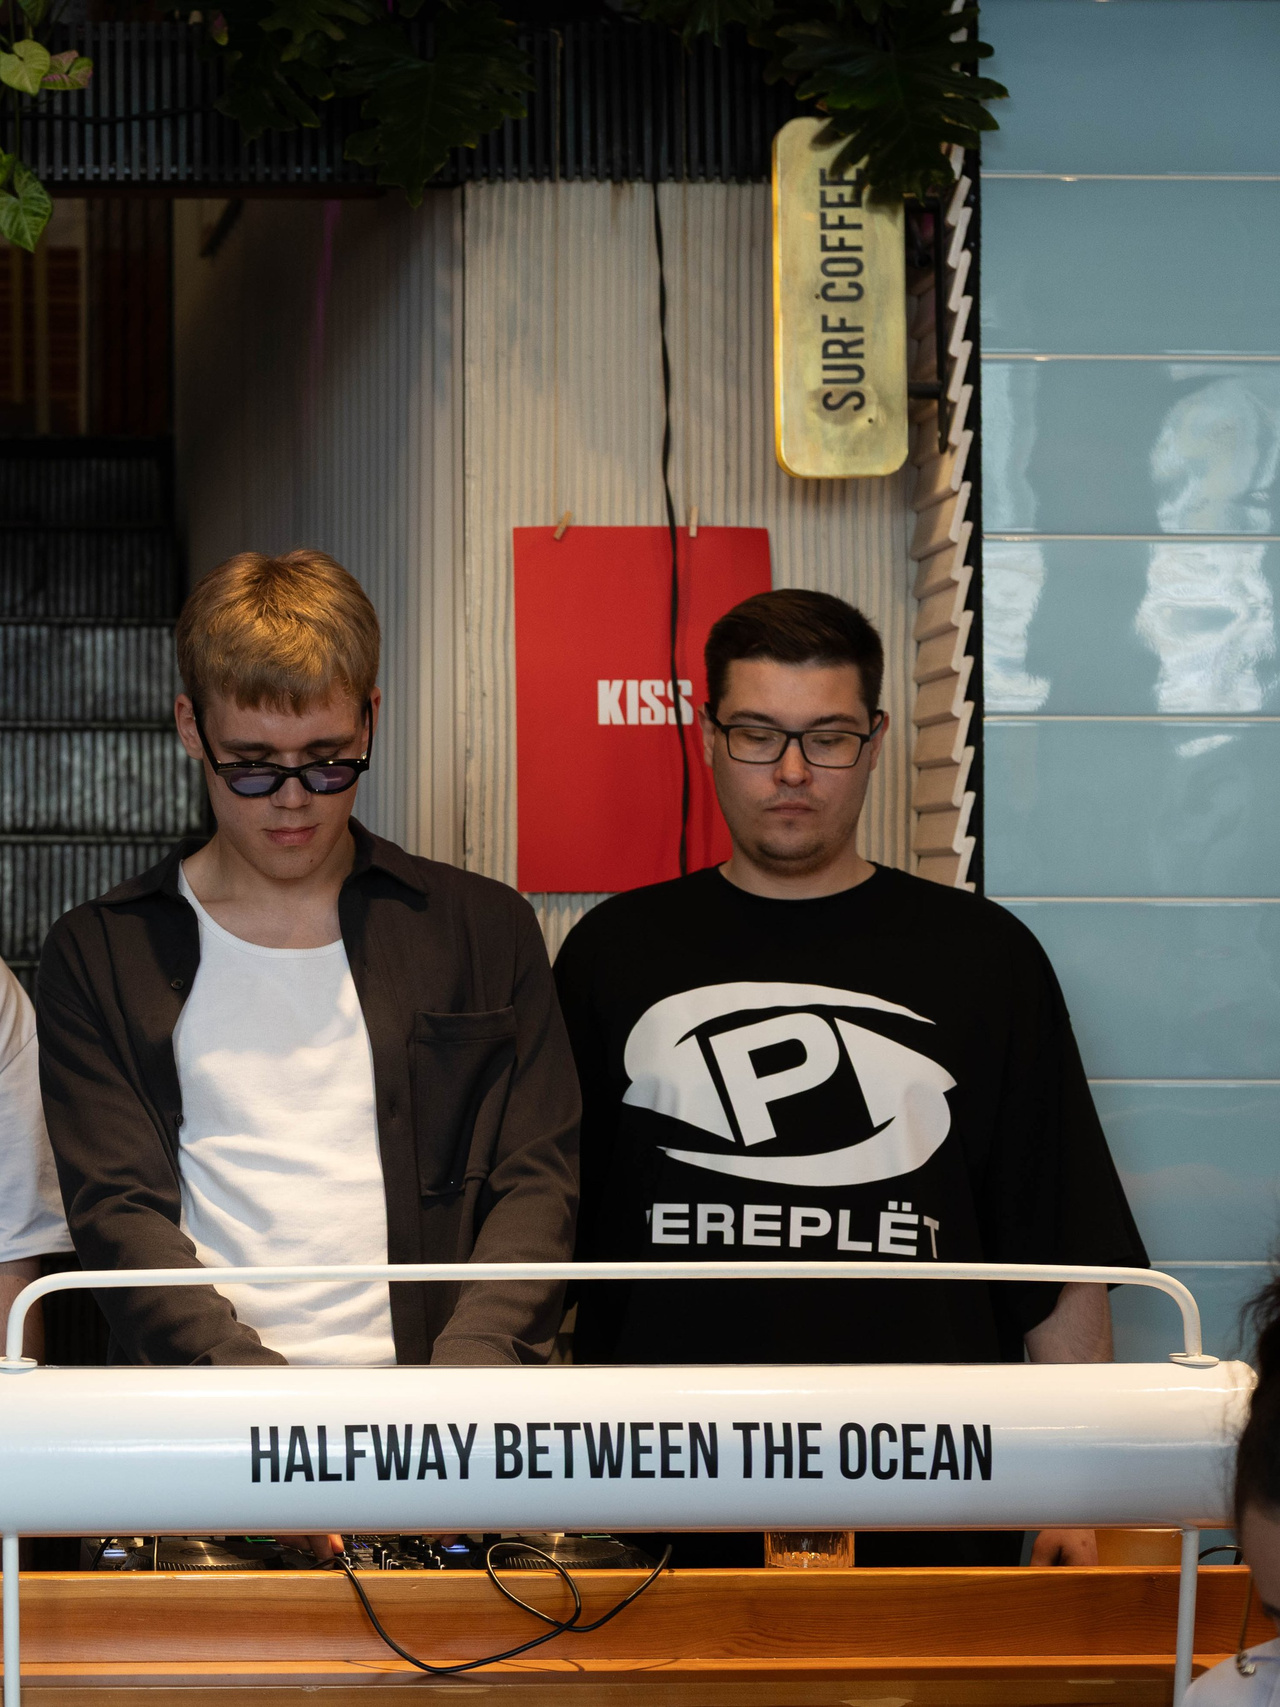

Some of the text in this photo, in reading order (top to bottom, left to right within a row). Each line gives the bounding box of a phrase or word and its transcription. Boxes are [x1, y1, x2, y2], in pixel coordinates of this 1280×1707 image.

[819, 167, 866, 411] SURF COFFEE
[597, 679, 694, 725] KISS
[250, 1422, 992, 1483] HALFWAY BETWEEN THE OCEAN
